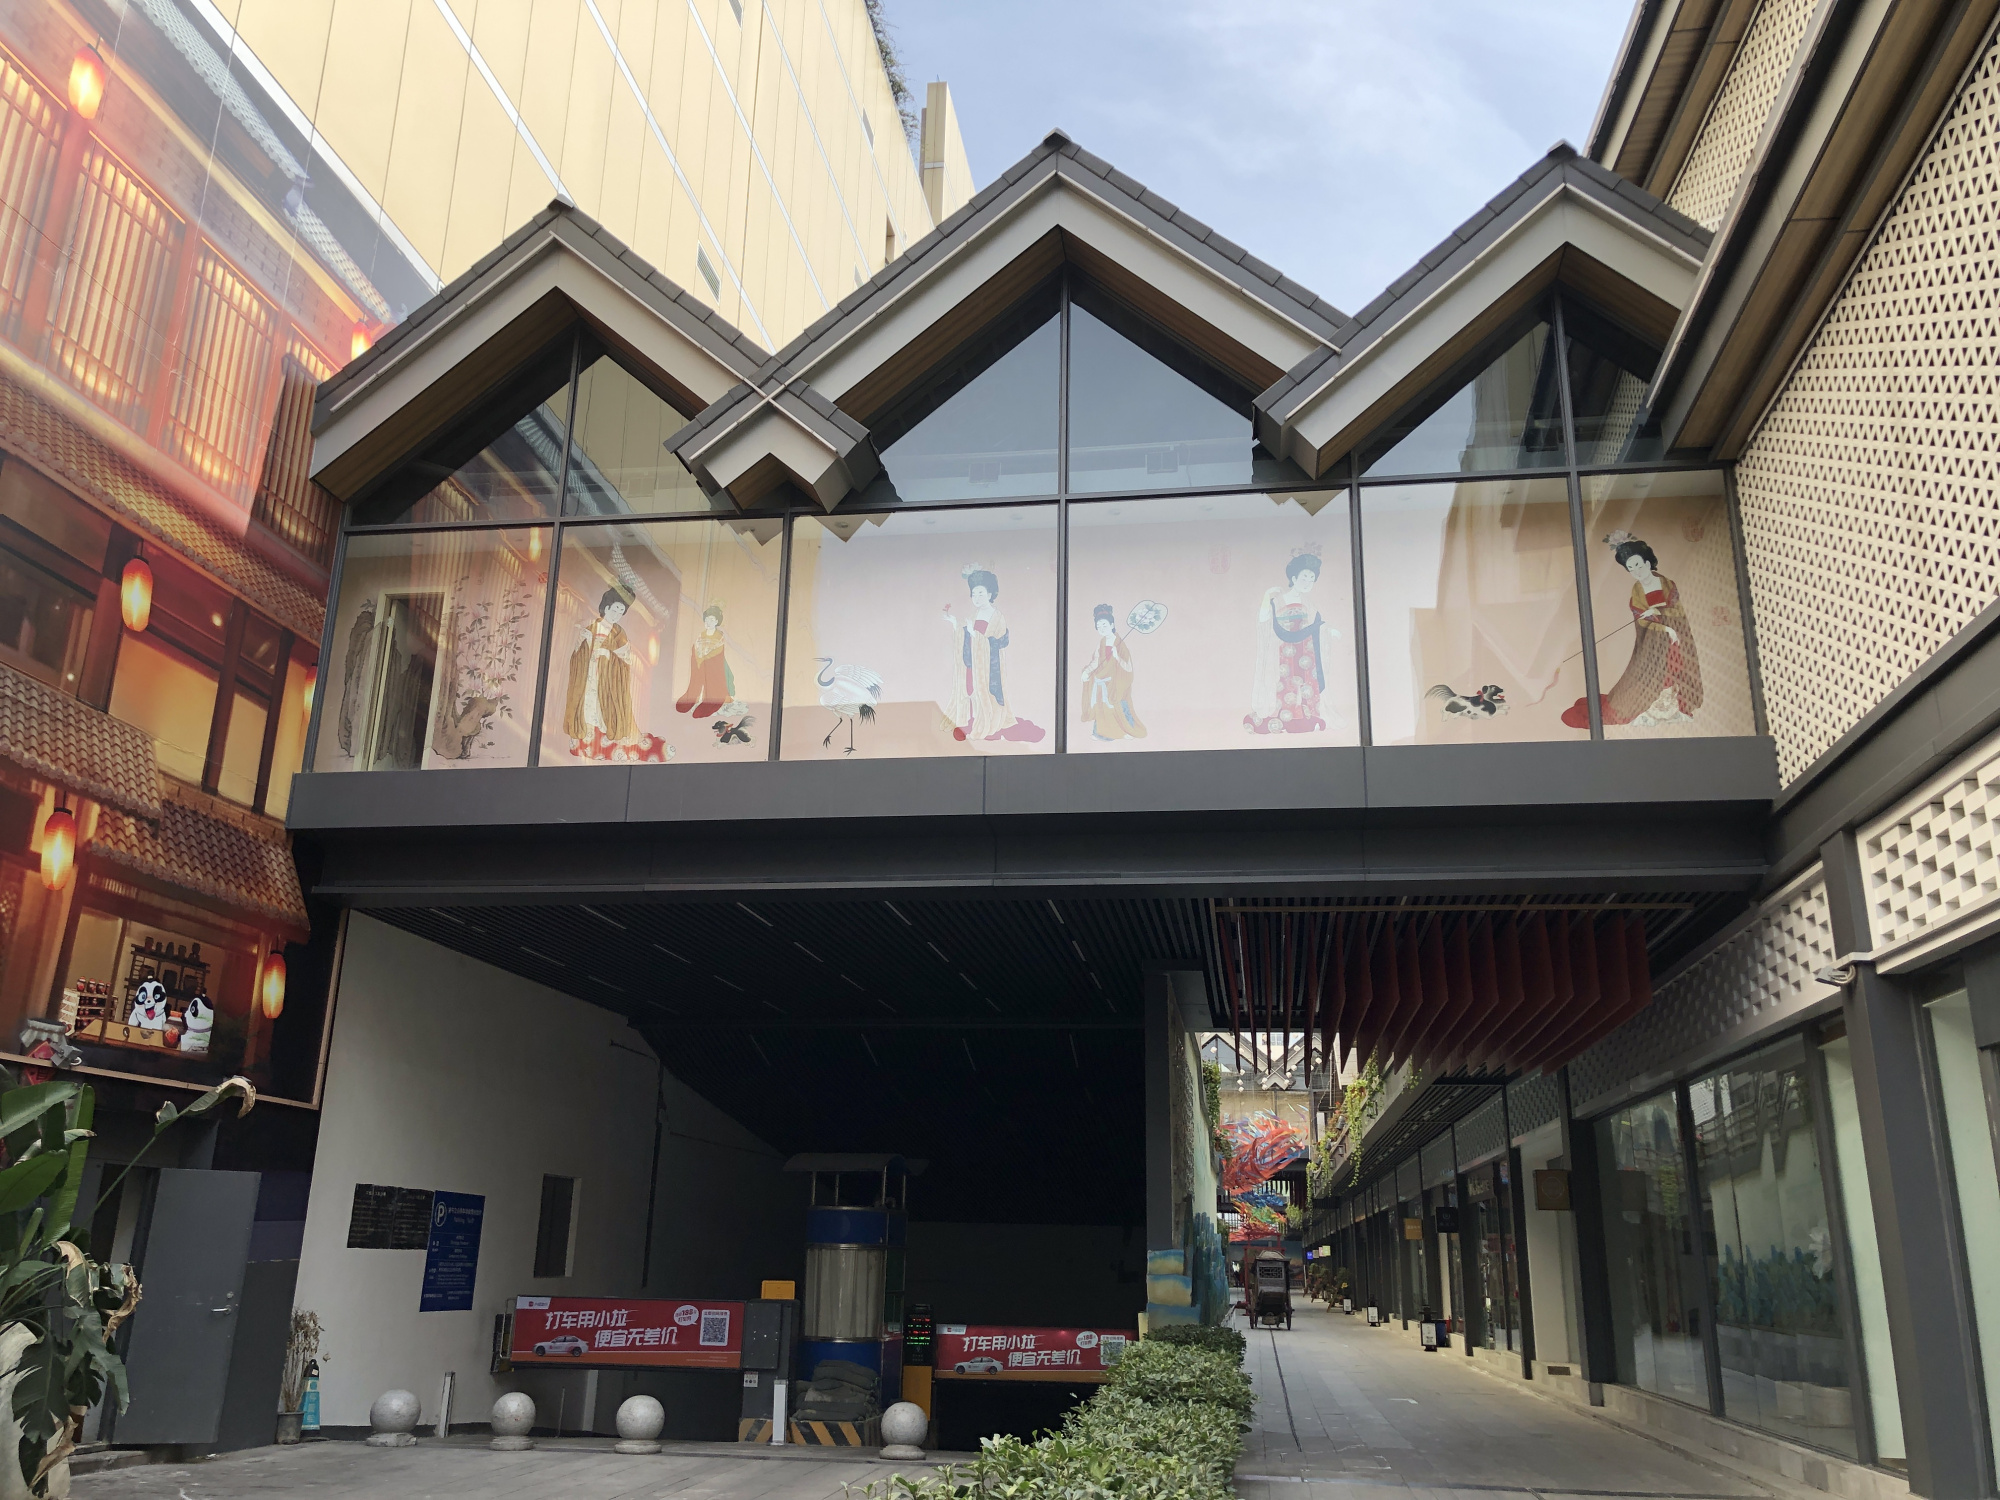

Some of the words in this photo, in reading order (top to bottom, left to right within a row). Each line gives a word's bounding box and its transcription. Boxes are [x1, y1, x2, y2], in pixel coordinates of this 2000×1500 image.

[545, 1309, 629, 1330] 打车用小拉
[594, 1327, 678, 1347] 便宜无差价
[962, 1334, 1036, 1352] 打车用小拉
[1008, 1349, 1081, 1367] 便宜无差价
